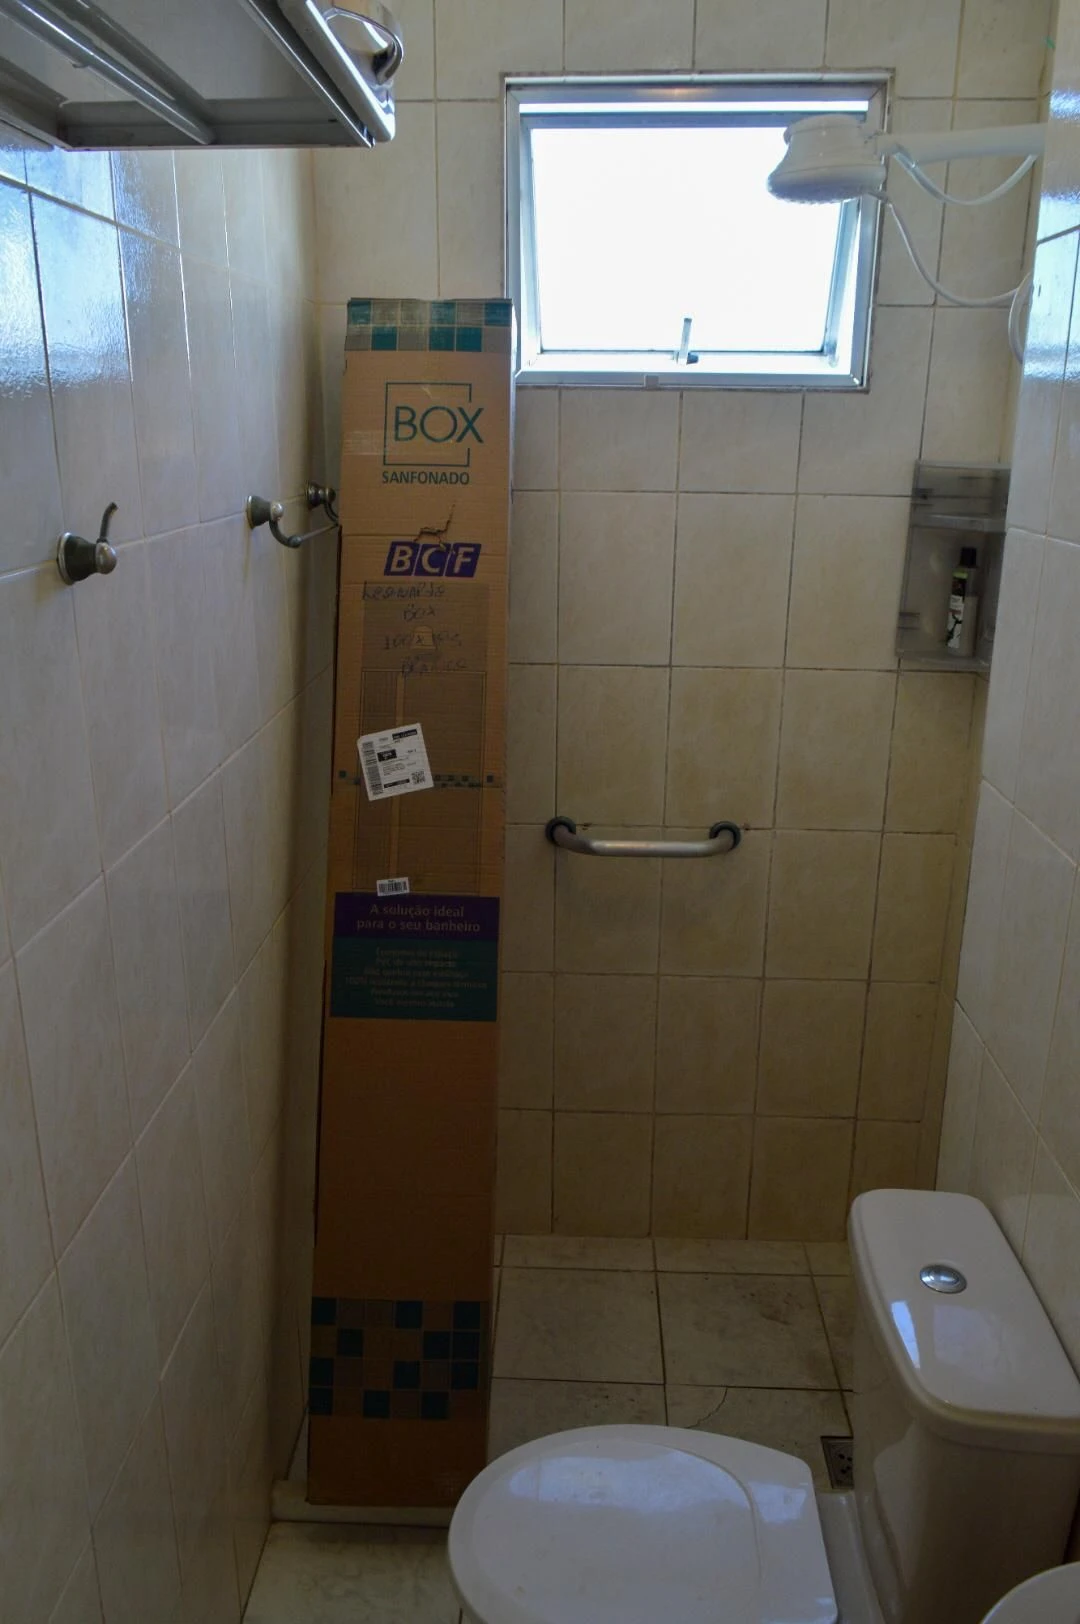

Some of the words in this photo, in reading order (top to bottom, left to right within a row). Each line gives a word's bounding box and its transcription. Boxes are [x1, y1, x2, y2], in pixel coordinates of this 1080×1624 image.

[393, 406, 485, 444] BOX
[381, 470, 470, 486] SANFONADO
[388, 543, 478, 576] BCF
[369, 903, 379, 915] A
[382, 903, 430, 919] solução
[434, 905, 465, 917] ideal
[356, 919, 384, 931] para
[387, 920, 397, 930] o
[399, 920, 421, 931] seu
[425, 919, 481, 933] banheiro
